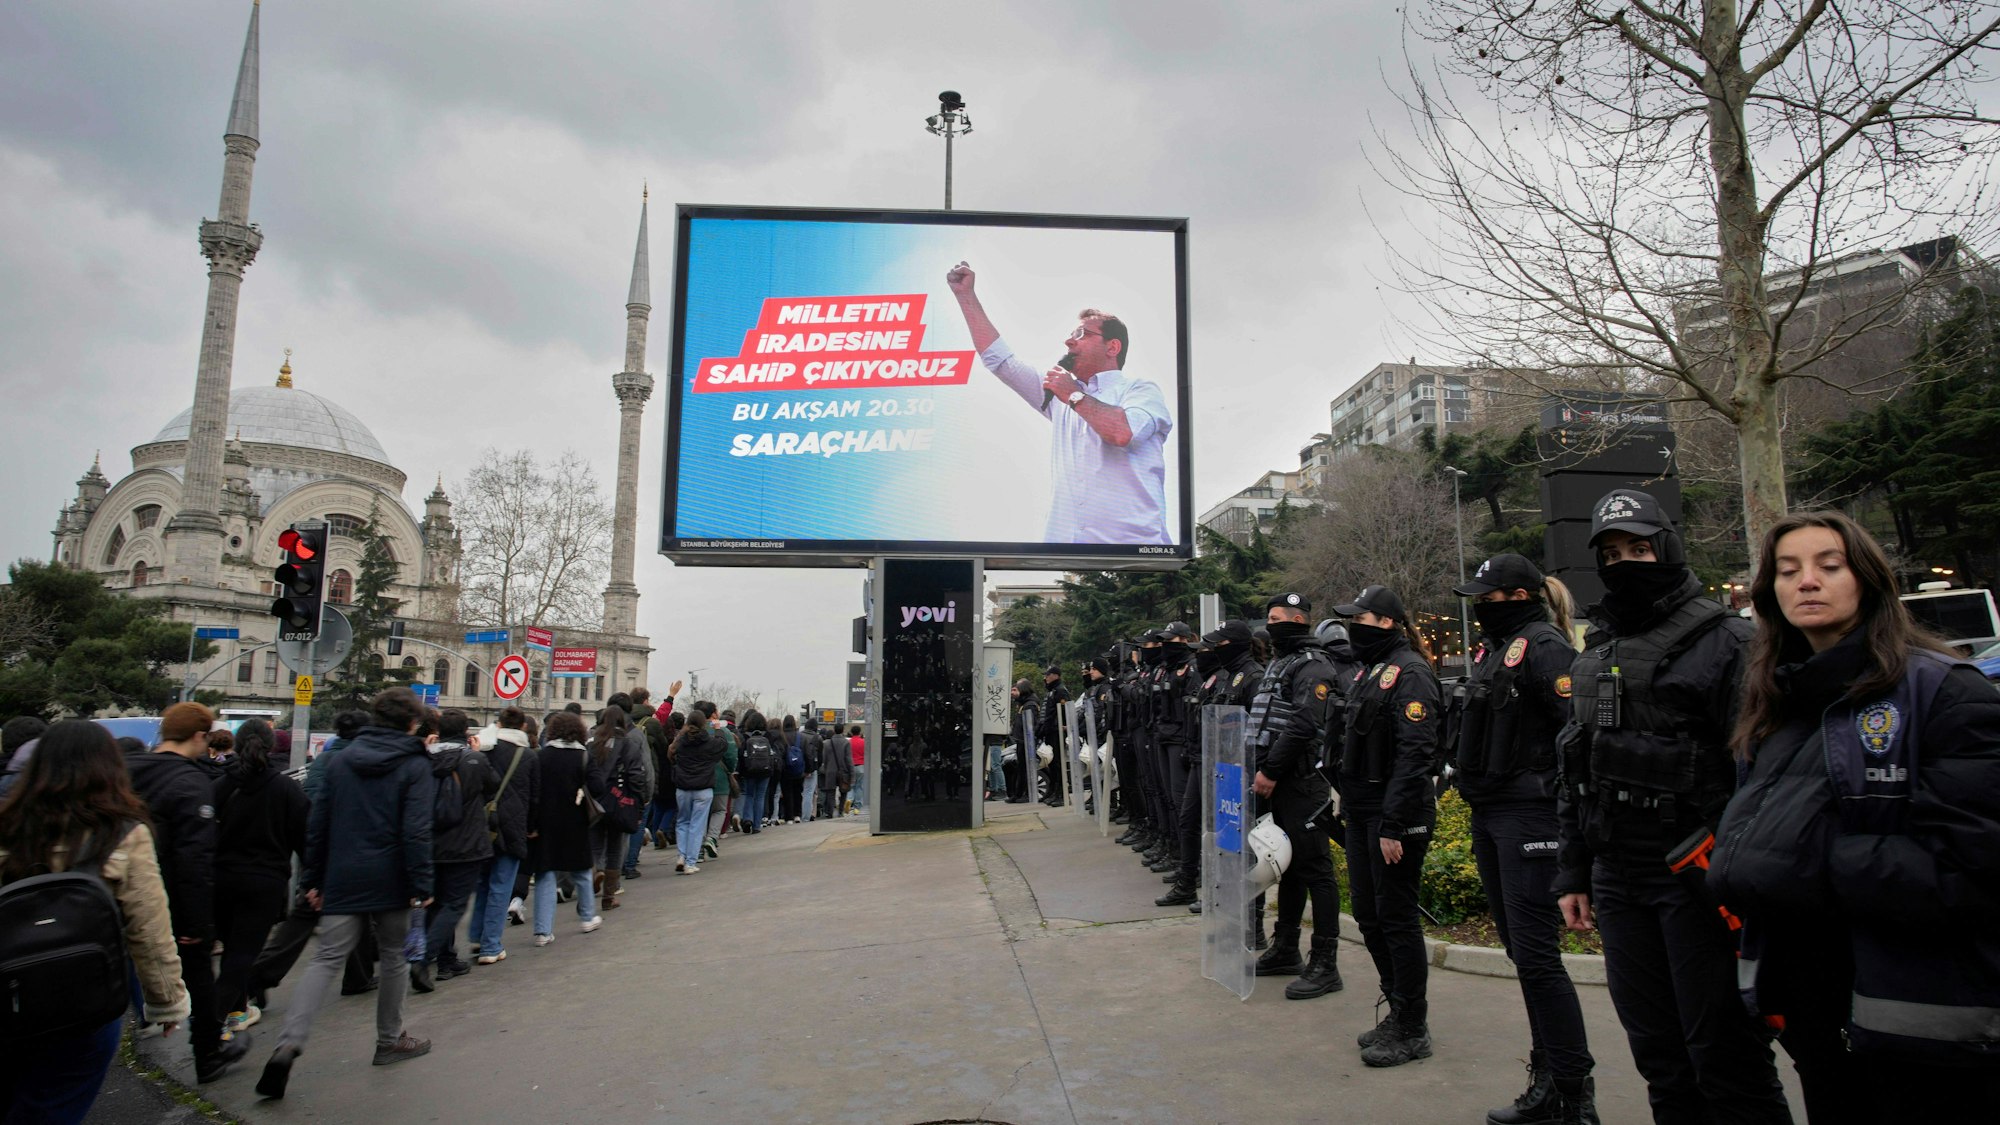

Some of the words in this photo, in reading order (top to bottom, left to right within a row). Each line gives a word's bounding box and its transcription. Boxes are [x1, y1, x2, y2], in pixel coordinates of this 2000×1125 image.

[777, 302, 910, 325] MİLLETİN
[756, 330, 912, 354] İRADESİNE
[707, 362, 796, 385] SAHİP
[802, 358, 960, 385] ÇIKIYORUZ
[732, 403, 769, 421] BU
[772, 401, 860, 422] AKŞAM
[865, 399, 935, 417] 20.30
[729, 428, 936, 459] SARAÇHANE
[680, 540, 710, 548] İSTANBUL
[710, 540, 749, 549] BÜYÜKŞEHİR
[750, 541, 785, 549] BELEDİYESİ
[1138, 546, 1163, 554] KÜLTÜR
[900, 601, 956, 628] yovi
[284, 632, 312, 641] 07-012
[554, 651, 596, 659] DOLMABAHÇE
[554, 659, 584, 667] GAZHANE
